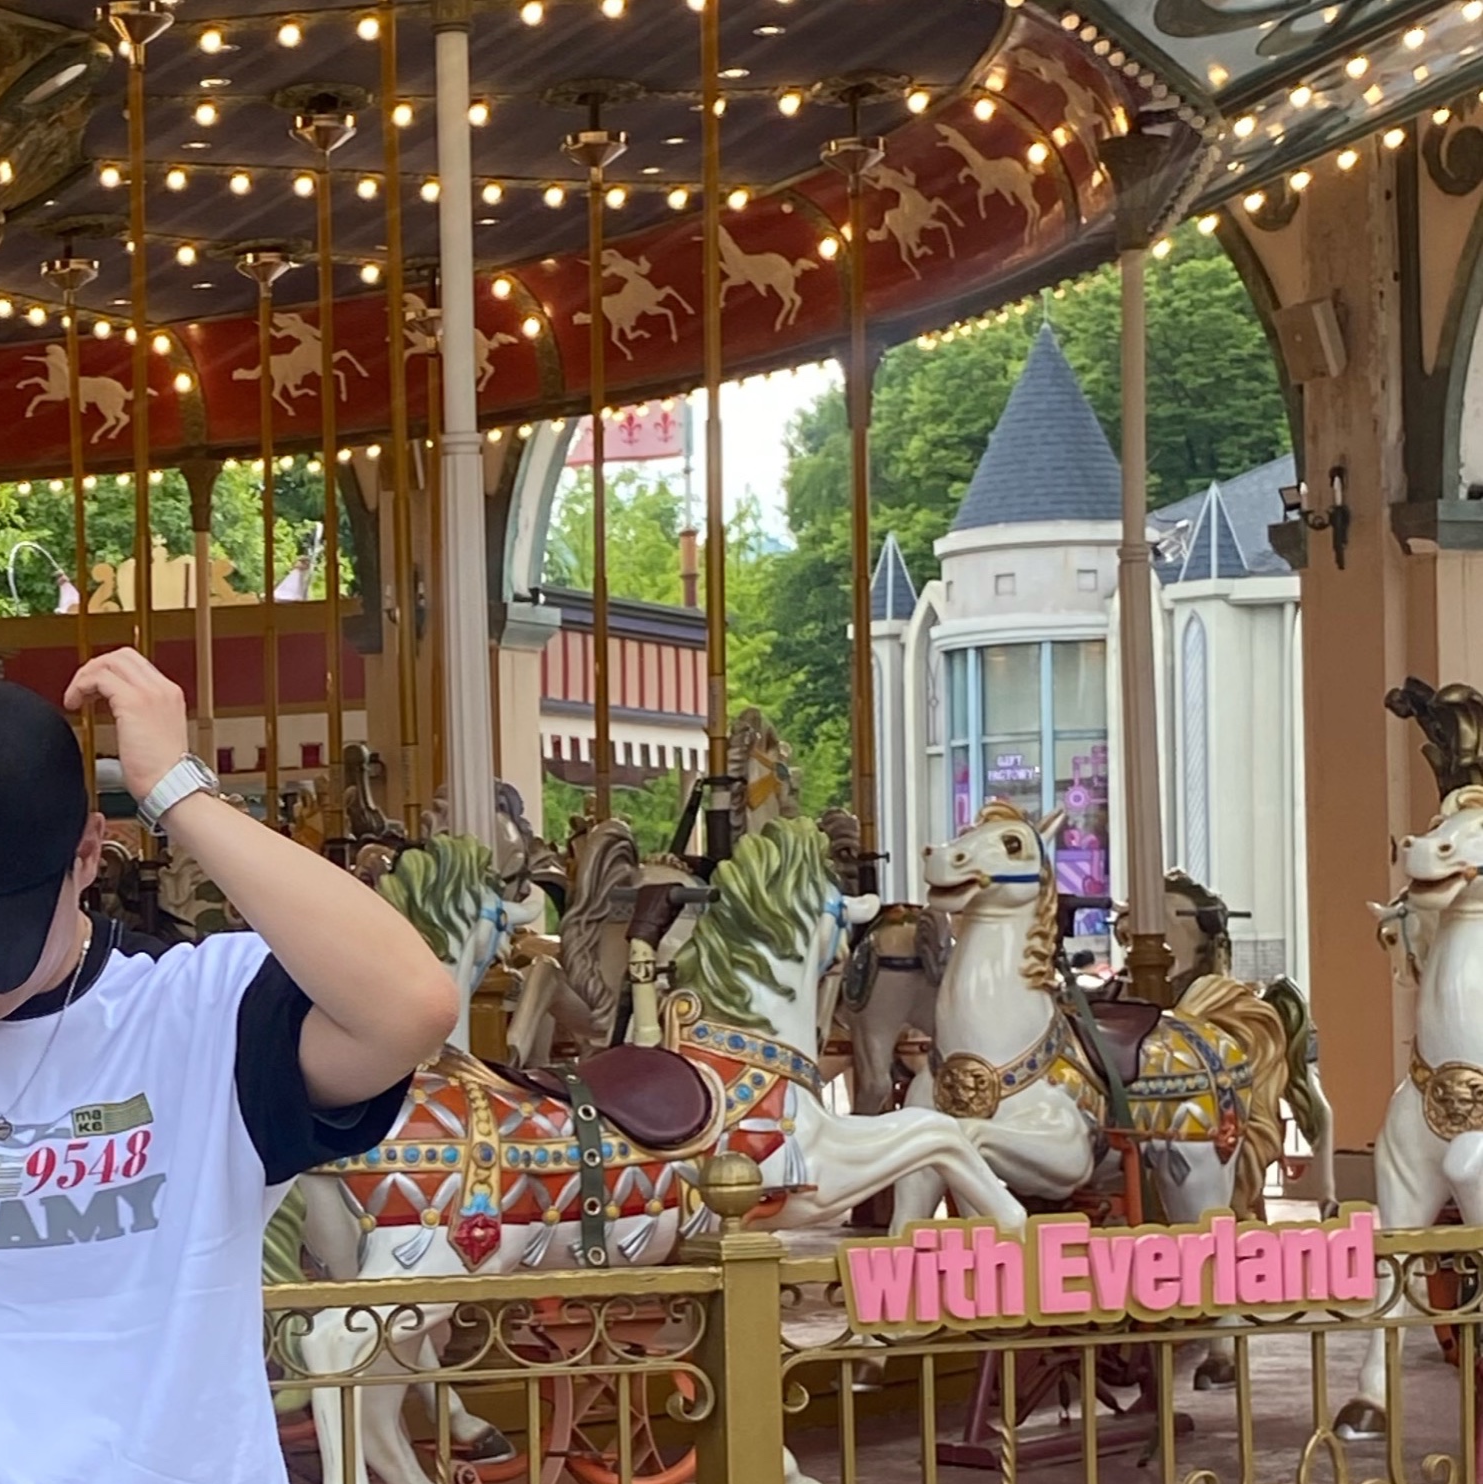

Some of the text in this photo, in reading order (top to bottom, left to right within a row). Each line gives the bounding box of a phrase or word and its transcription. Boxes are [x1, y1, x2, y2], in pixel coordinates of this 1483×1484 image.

[24, 1129, 152, 1197] 9548
[847, 1211, 1375, 1324] with Everland
